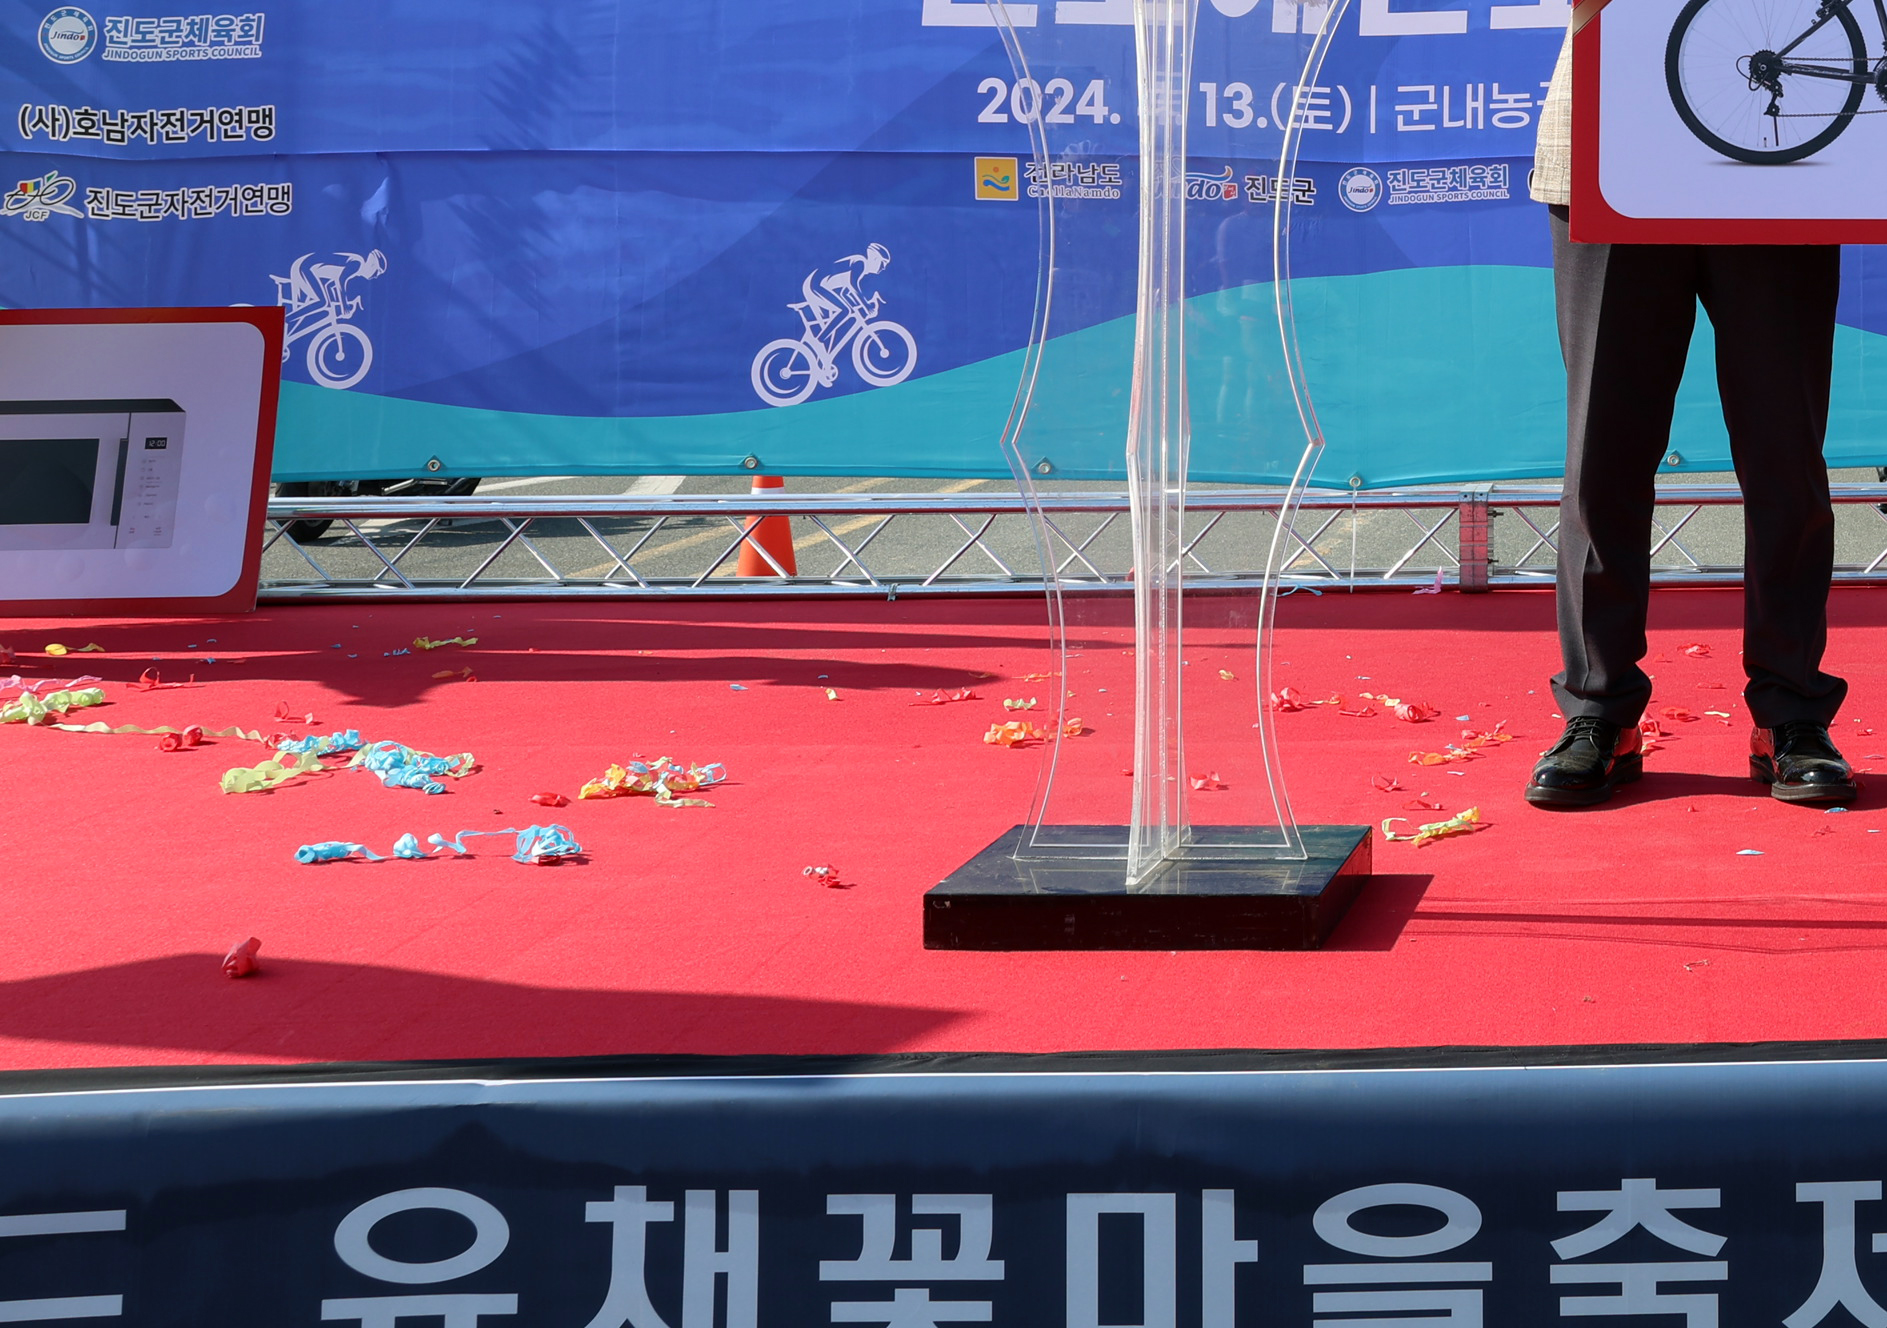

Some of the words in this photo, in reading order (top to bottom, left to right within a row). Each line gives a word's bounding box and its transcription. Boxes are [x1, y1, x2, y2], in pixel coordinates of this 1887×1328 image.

[104, 14, 264, 46] 진도군체육회
[102, 48, 163, 61] JINDOGUN
[165, 47, 209, 60] SPORTS
[211, 45, 262, 58] COUNCIL
[977, 77, 1121, 125] 2024.
[1200, 81, 1352, 135] 13.(토)
[1394, 81, 1556, 133] 군내농
[19, 105, 275, 144] (사)호남자전거연맹
[1388, 165, 1508, 192] 진도군체육회
[86, 183, 292, 221] 진도군자전거연맹
[1389, 193, 1435, 204] JINDOGUN
[1436, 191, 1470, 202] SPORTS
[1471, 189, 1509, 199] COUNCIL
[25, 210, 48, 220] JCF
